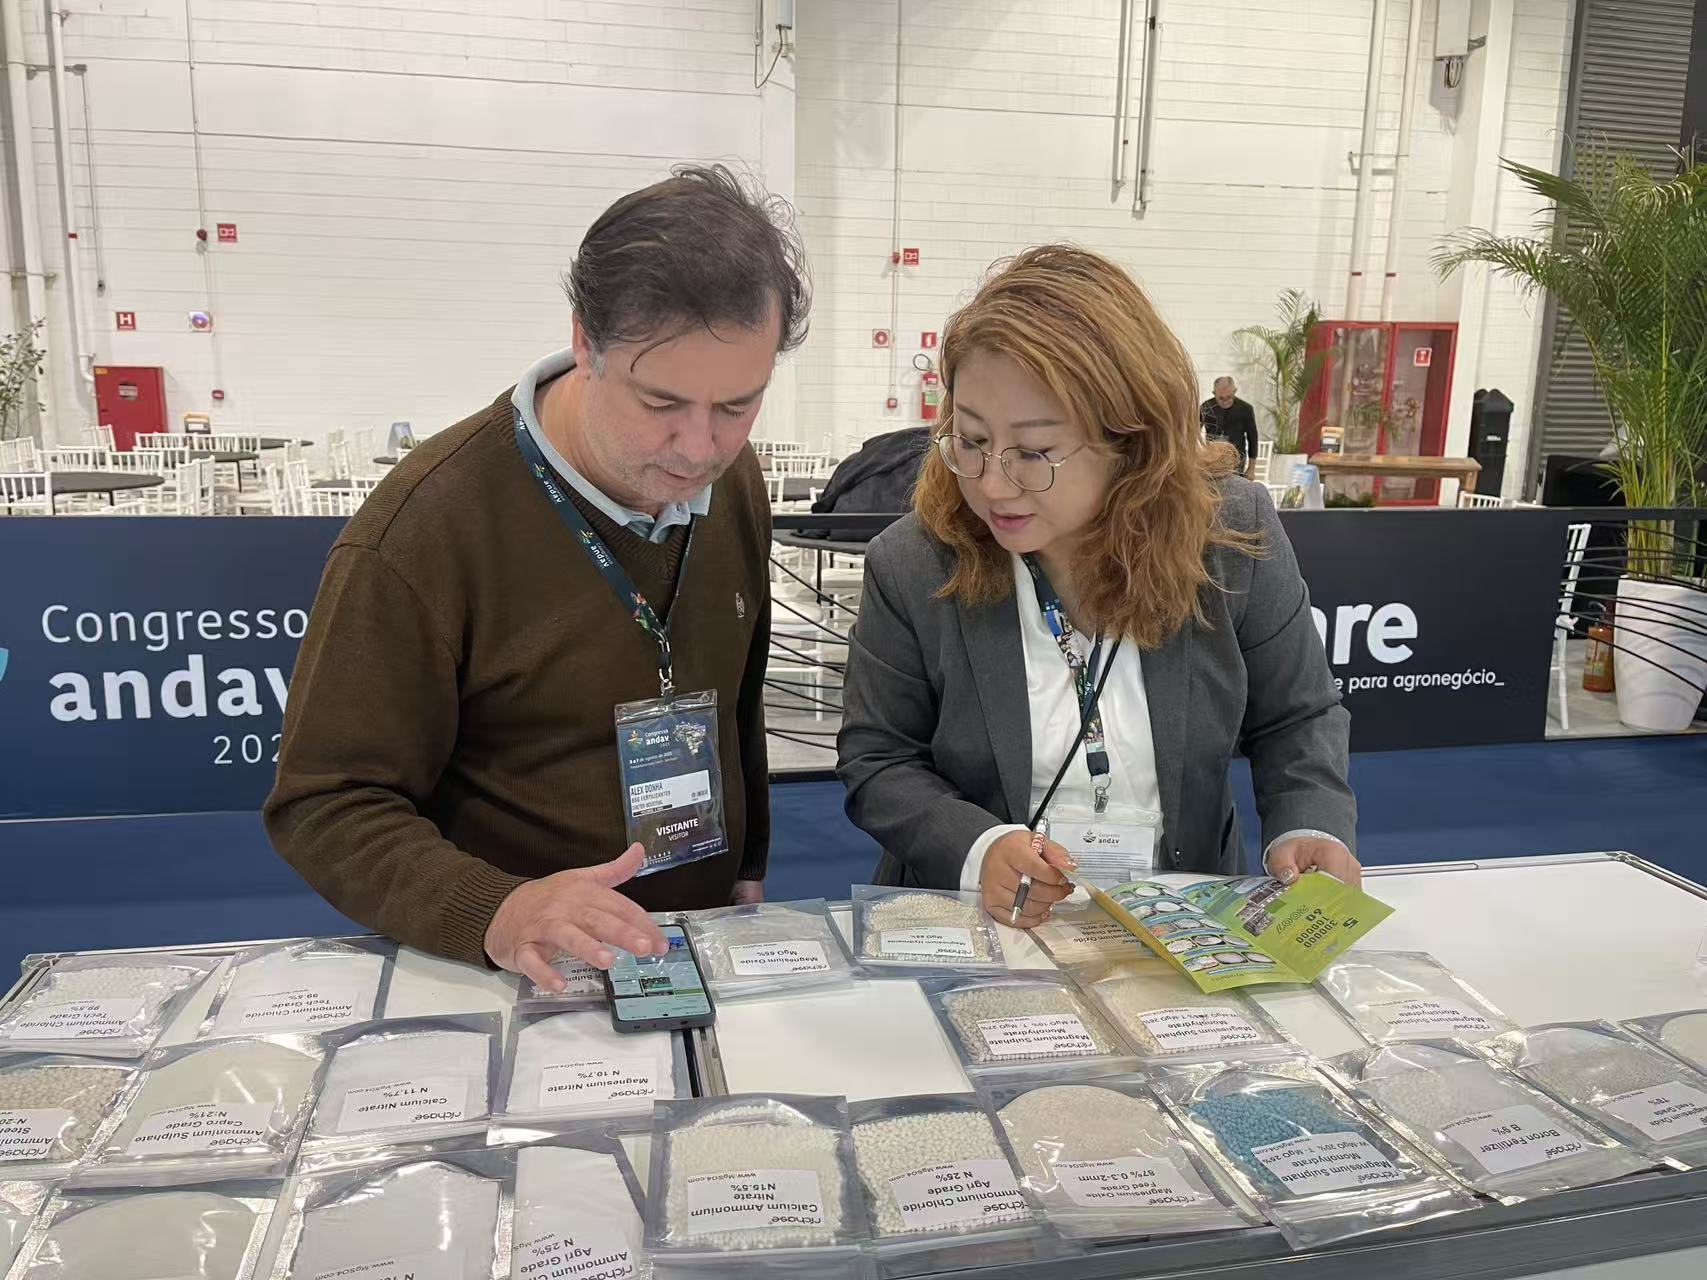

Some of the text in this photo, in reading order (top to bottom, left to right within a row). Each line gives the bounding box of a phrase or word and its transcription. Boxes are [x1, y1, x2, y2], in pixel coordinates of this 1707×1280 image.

[119, 314, 132, 325] H
[590, 545, 610, 567] andav
[42, 604, 309, 651] Congresso
[1349, 675, 1388, 695] para
[646, 735, 670, 746] andav
[213, 734, 282, 764] 20
[631, 786, 644, 796] ALEX
[656, 818, 699, 836] VISITANTE
[668, 831, 689, 841] VISITOR
[1343, 917, 1358, 929] 5
[565, 974, 593, 982] Sulph
[271, 1001, 303, 1009] Grade
[245, 1005, 353, 1019] Ammonium Chloride
[1168, 1020, 1229, 1029] Monohydrate
[1003, 1028, 1066, 1036] Monohydrate
[1156, 1025, 1252, 1040] Magnesium Sulphate
[989, 1038, 1032, 1046] Sulphate
[577, 1069, 620, 1079] N 10.7%
[546, 1078, 649, 1093] Magnesium Nitrate
[383, 1088, 416, 1099] 11.7%
[358, 1097, 448, 1113] Calcium Nitrate
[413, 1111, 461, 1122] richase
[165, 1119, 243, 1131] Capro Grade
[133, 1128, 265, 1143] Ammonium Sulphate
[1480, 1129, 1560, 1153] Boron Fertilizer
[0, 1137, 54, 1147] Ammoni
[1282, 1148, 1304, 1158] MgO
[1291, 1152, 1361, 1169] Monohydrate
[935, 1171, 974, 1183] N 25%
[1078, 1172, 1128, 1183] 0.3-2mm
[1281, 1160, 1392, 1183] Magnesium Sulphate
[730, 1183, 776, 1192] N15.5%
[927, 1180, 991, 1196] Agri Grade
[1100, 1181, 1157, 1192] Feed Grade
[733, 1193, 775, 1201] Nitrate
[1086, 1186, 1174, 1200] Magnesium Oxide
[691, 1203, 818, 1218] Calcium Ammonium
[902, 1197, 954, 1213] Chloride
[768, 1216, 821, 1226] richase
[511, 1233, 555, 1252] www.MgS
[532, 1238, 574, 1257] N 25%
[520, 1247, 592, 1274] Agri Grade
[551, 1252, 628, 1279] Ammonium
